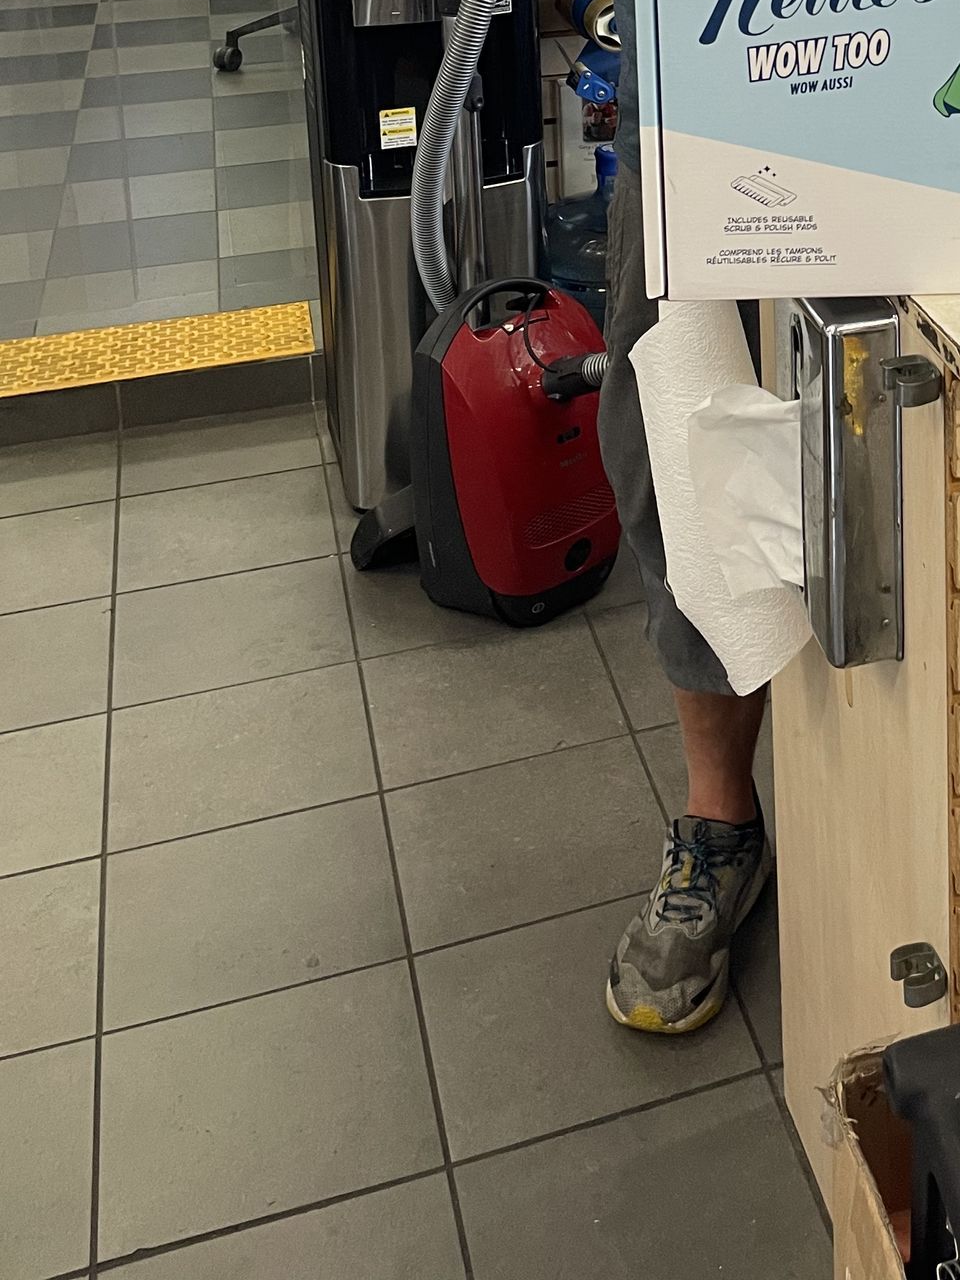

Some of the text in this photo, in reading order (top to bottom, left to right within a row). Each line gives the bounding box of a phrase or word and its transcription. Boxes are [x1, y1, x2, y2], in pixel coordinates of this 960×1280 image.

[747, 28, 890, 83] WOW TOO
[790, 76, 853, 95] WOW AUSSI
[727, 215, 814, 224] INCLUDES REUSABLE
[724, 225, 752, 233] SCRUB
[764, 224, 793, 232] POLISH
[796, 223, 818, 231] PADS
[719, 249, 764, 257] COMPREND
[785, 247, 823, 255] TAMPONS
[706, 256, 767, 265] RÉUTILISABLES
